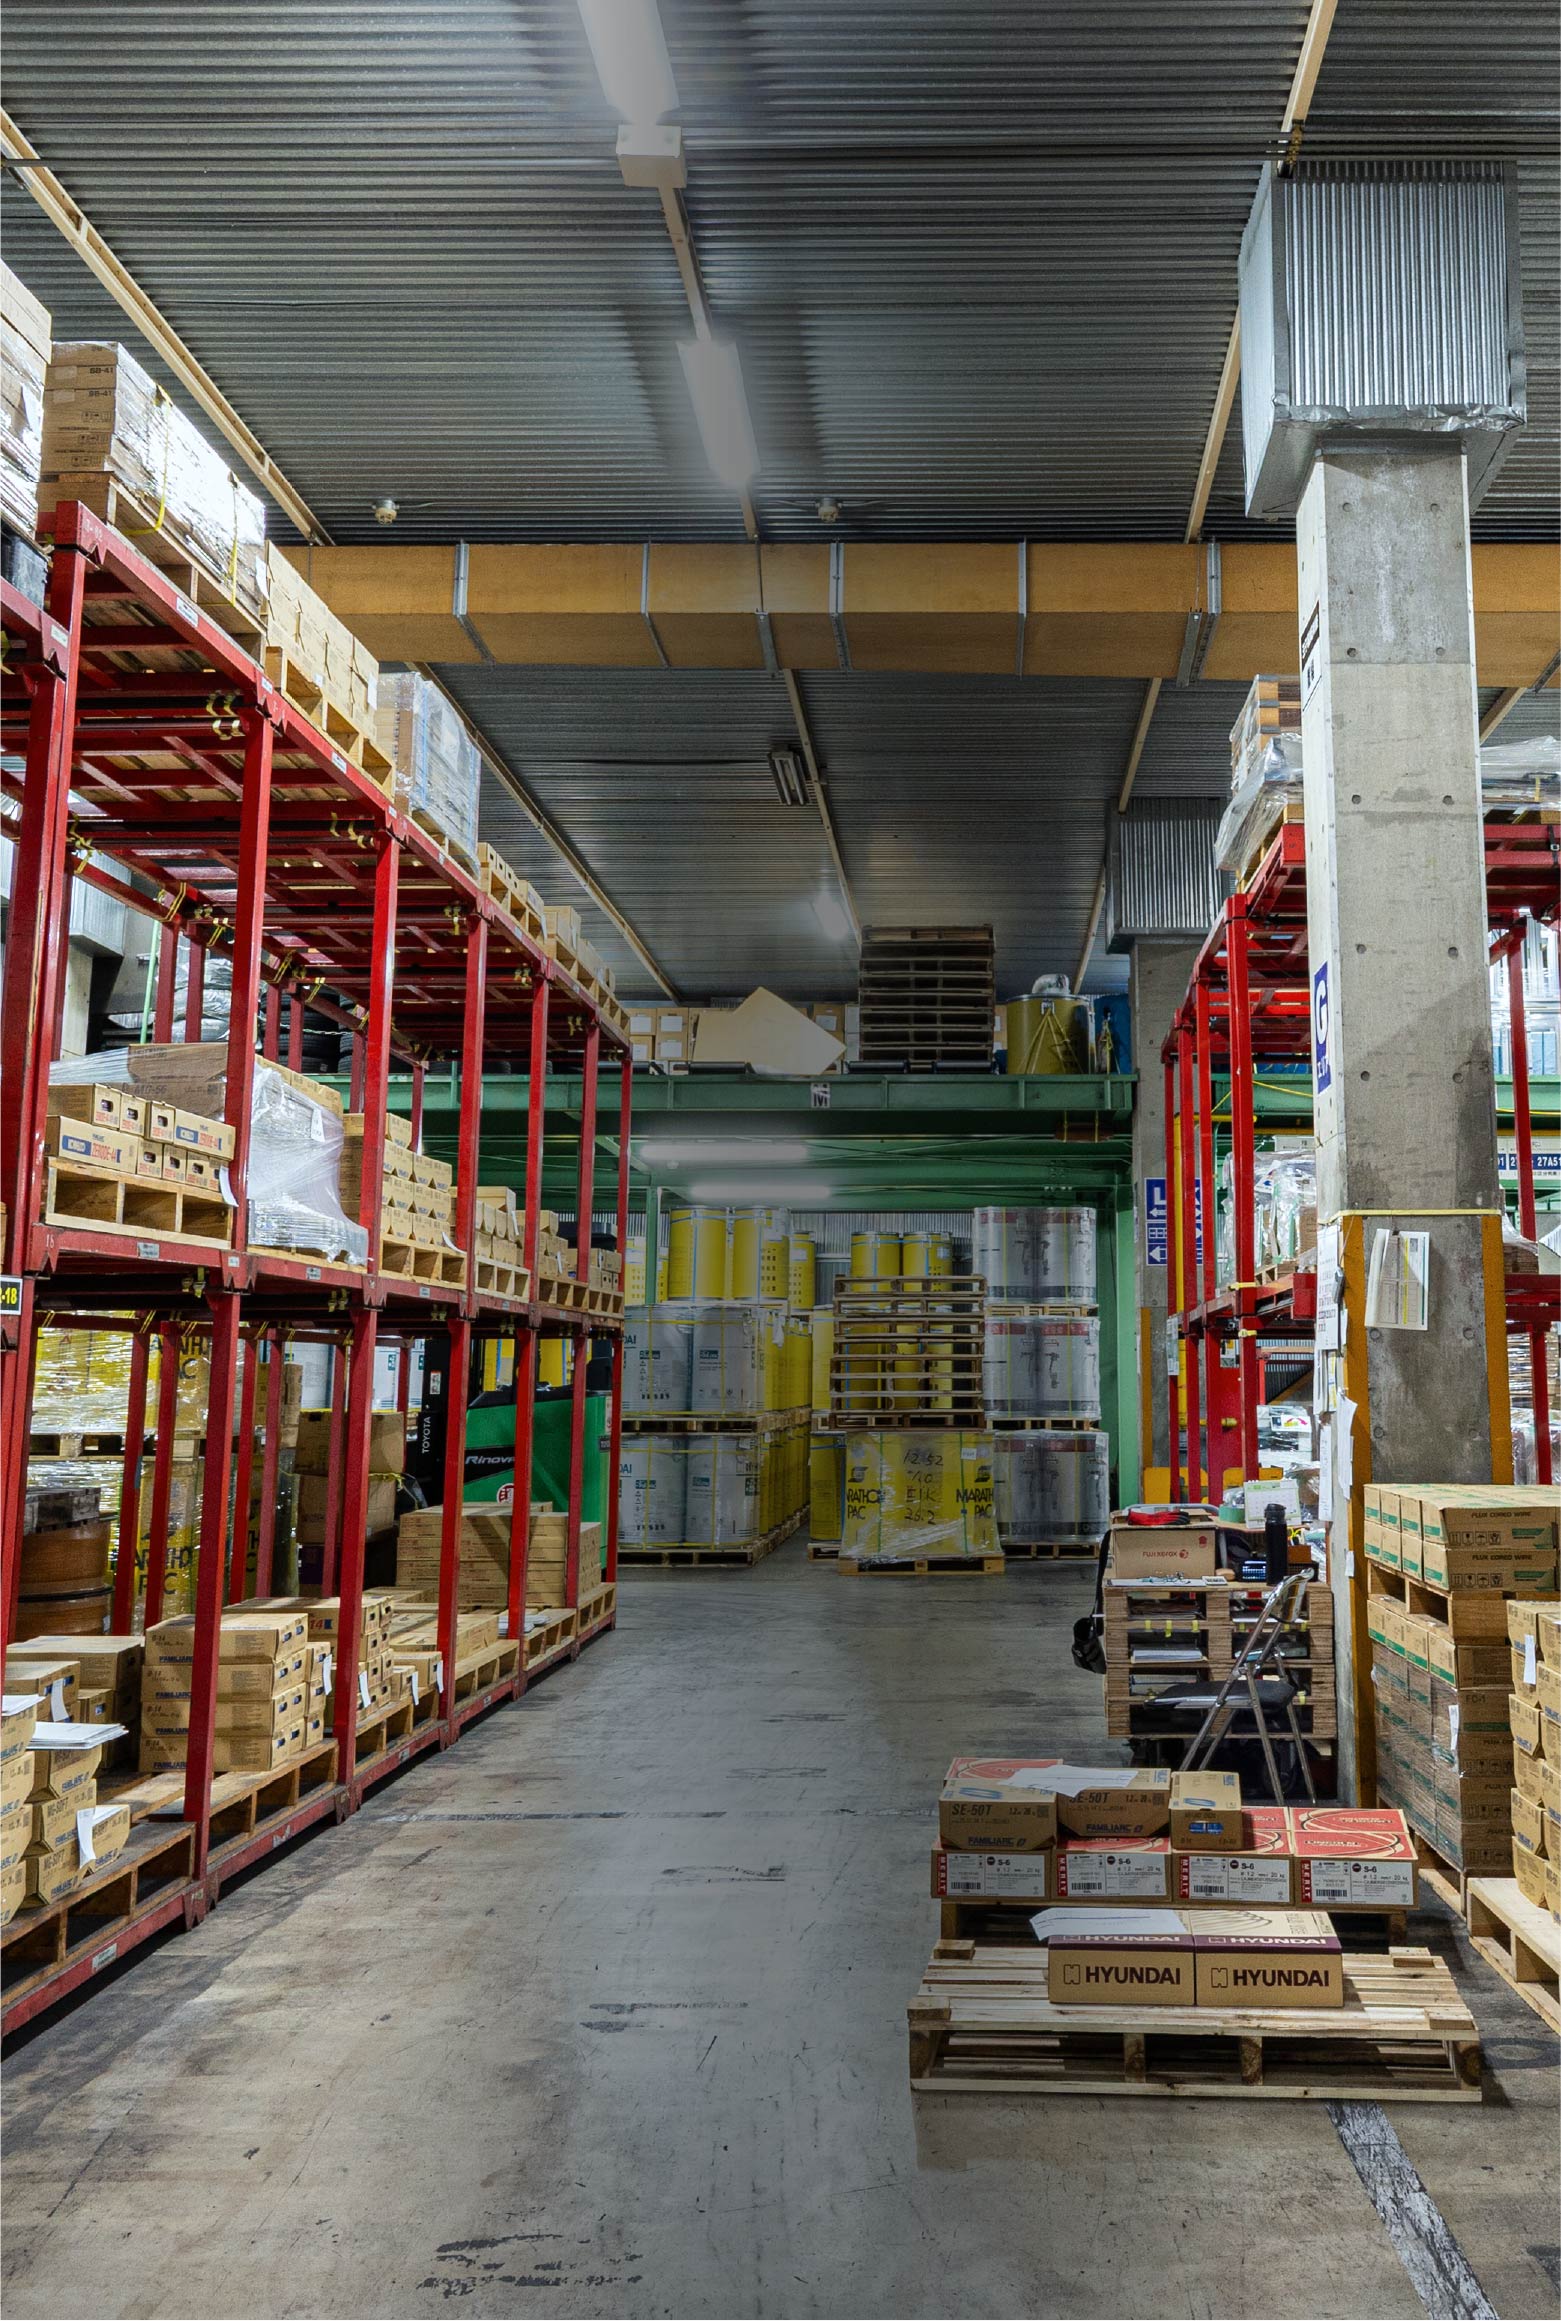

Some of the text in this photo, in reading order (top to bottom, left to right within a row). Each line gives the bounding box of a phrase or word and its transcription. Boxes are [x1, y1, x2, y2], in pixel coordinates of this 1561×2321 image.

[1315, 980, 1329, 1045] G
[422, 1416, 432, 1454] TOYOTA
[847, 1505, 867, 1520] PAC
[974, 1504, 993, 1519] PAC
[1471, 1511, 1488, 1519] FLUX
[1472, 1553, 1533, 1561] FLUX CORED WIRE
[951, 1803, 993, 1816] SE-50T
[1085, 1823, 1133, 1833] FAMILIARC
[967, 1836, 1015, 1847] FAMILIARC
[1303, 1863, 1311, 1899] MERIT
[1083, 1935, 1181, 1943] HYUNDAI
[1230, 1936, 1327, 1945] HYUNDAI
[1085, 1966, 1181, 1985] HYUNDAI
[1232, 1969, 1330, 1988] HYUNDAI
